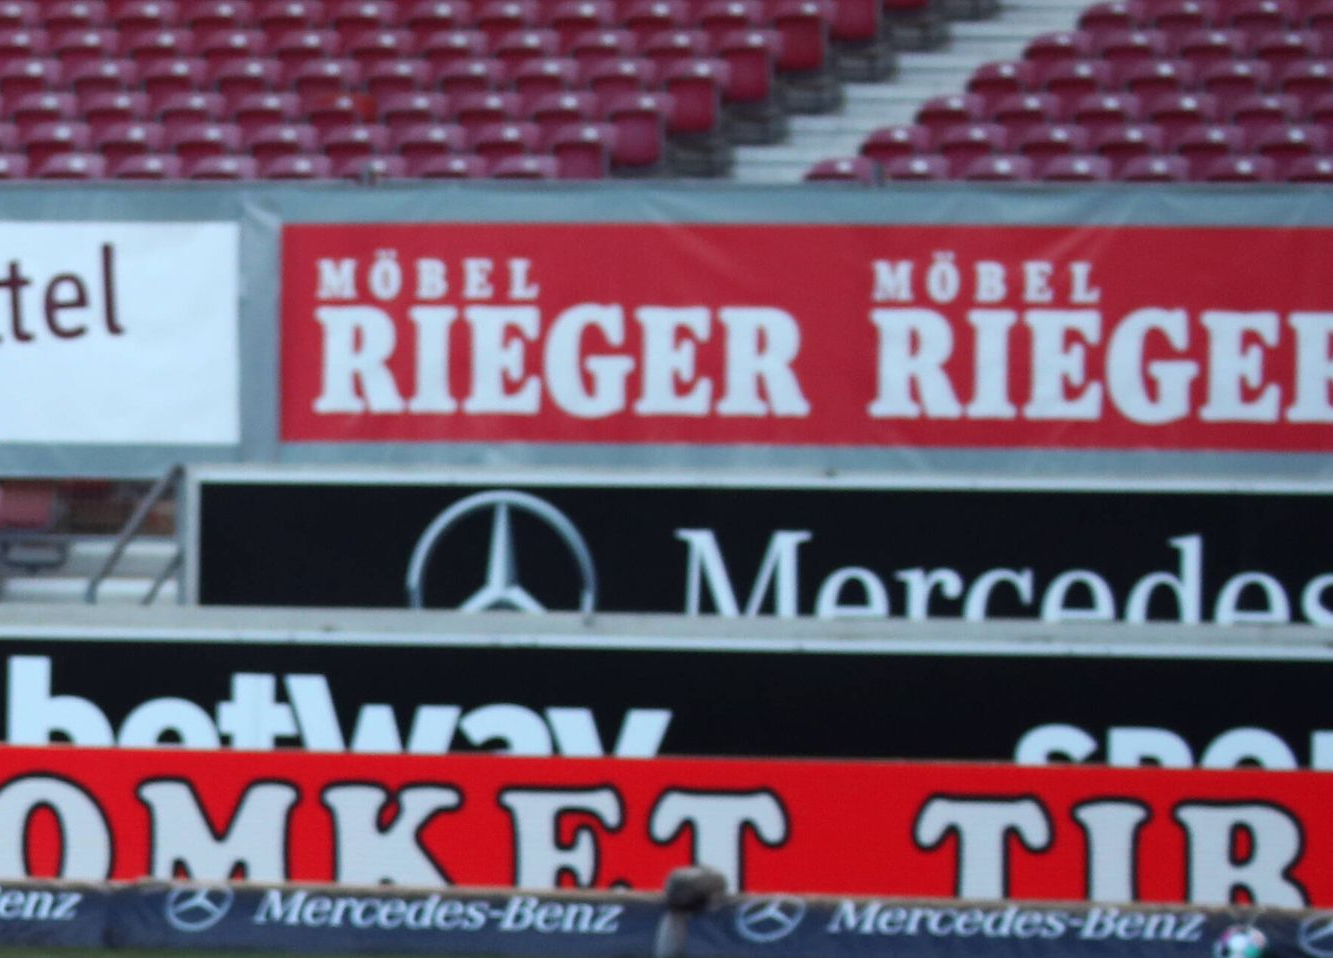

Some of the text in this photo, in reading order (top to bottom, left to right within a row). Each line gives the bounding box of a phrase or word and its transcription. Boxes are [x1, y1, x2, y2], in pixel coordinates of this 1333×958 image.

[317, 249, 539, 301] MÖBEL
[872, 252, 1101, 304] MÖBEL
[313, 303, 810, 421] RIEGER
[254, 889, 620, 931] Mercedes-Benz
[828, 899, 1207, 941] Mercedes-Benz
